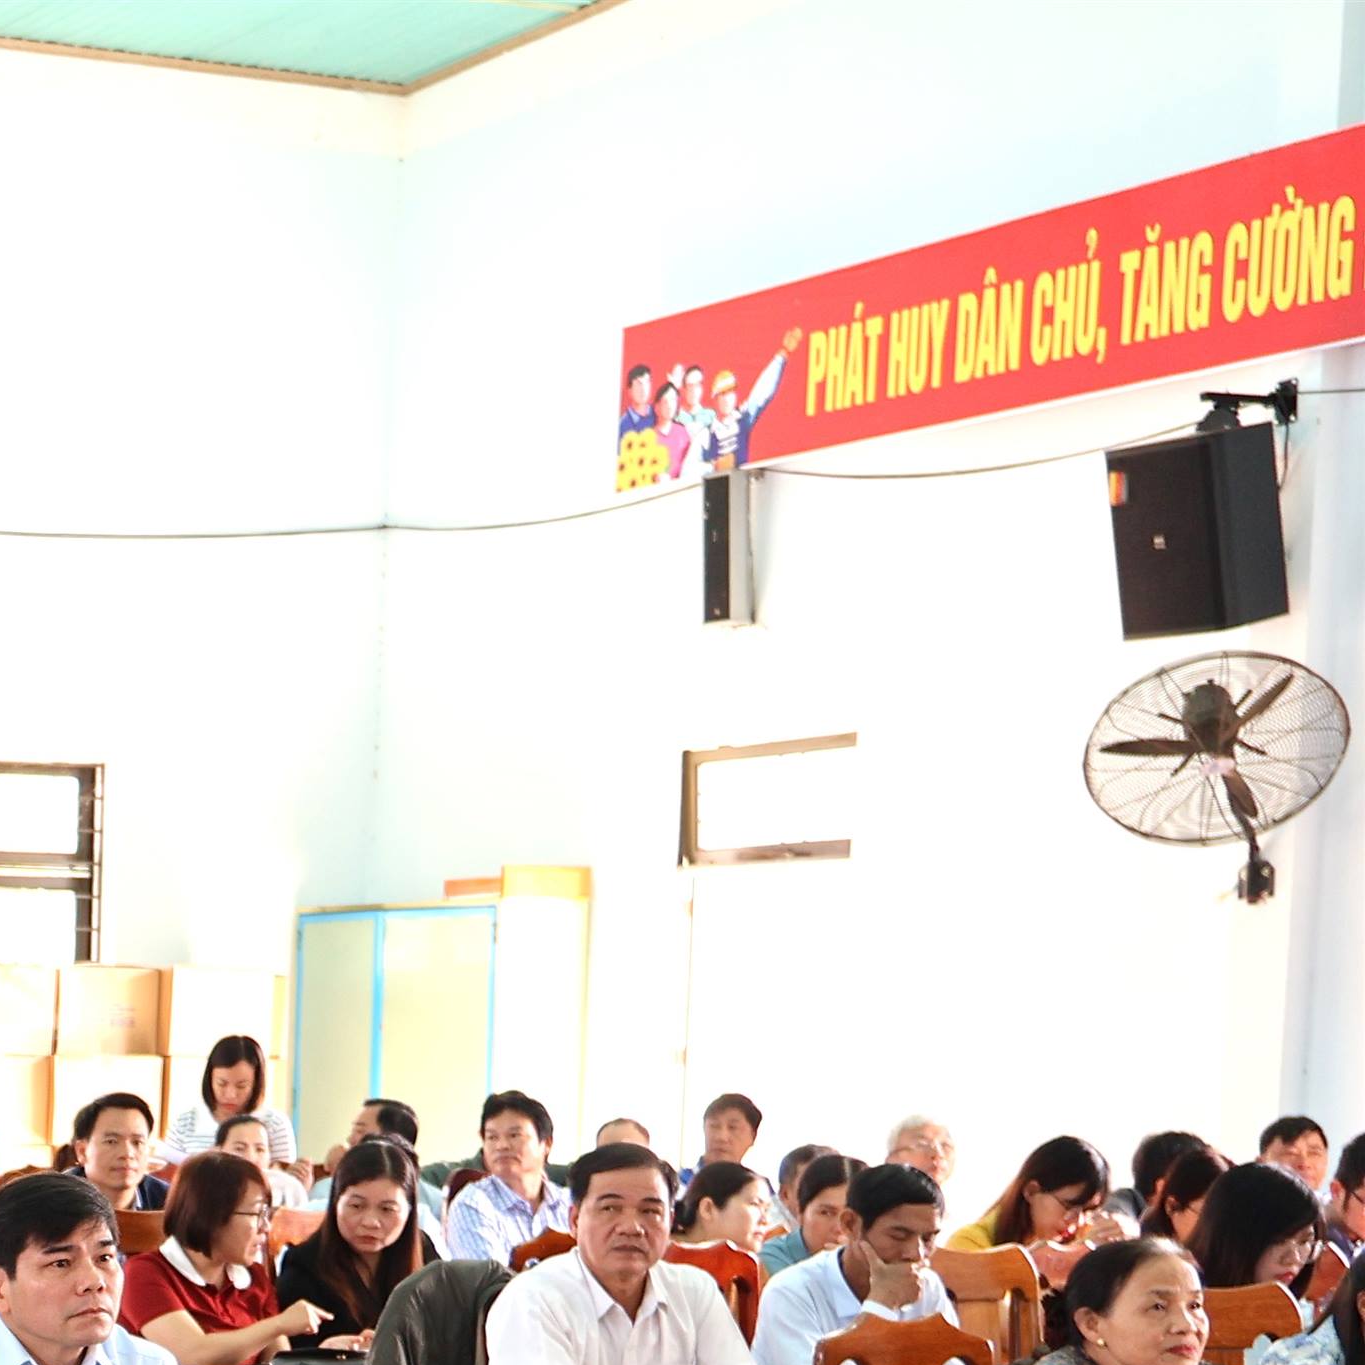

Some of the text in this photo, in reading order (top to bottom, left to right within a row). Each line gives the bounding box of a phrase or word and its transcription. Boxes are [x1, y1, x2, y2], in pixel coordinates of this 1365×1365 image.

[806, 185, 1357, 416] PHÁT HUY DÂN CHỦ, TĂNG CƯỜNG
